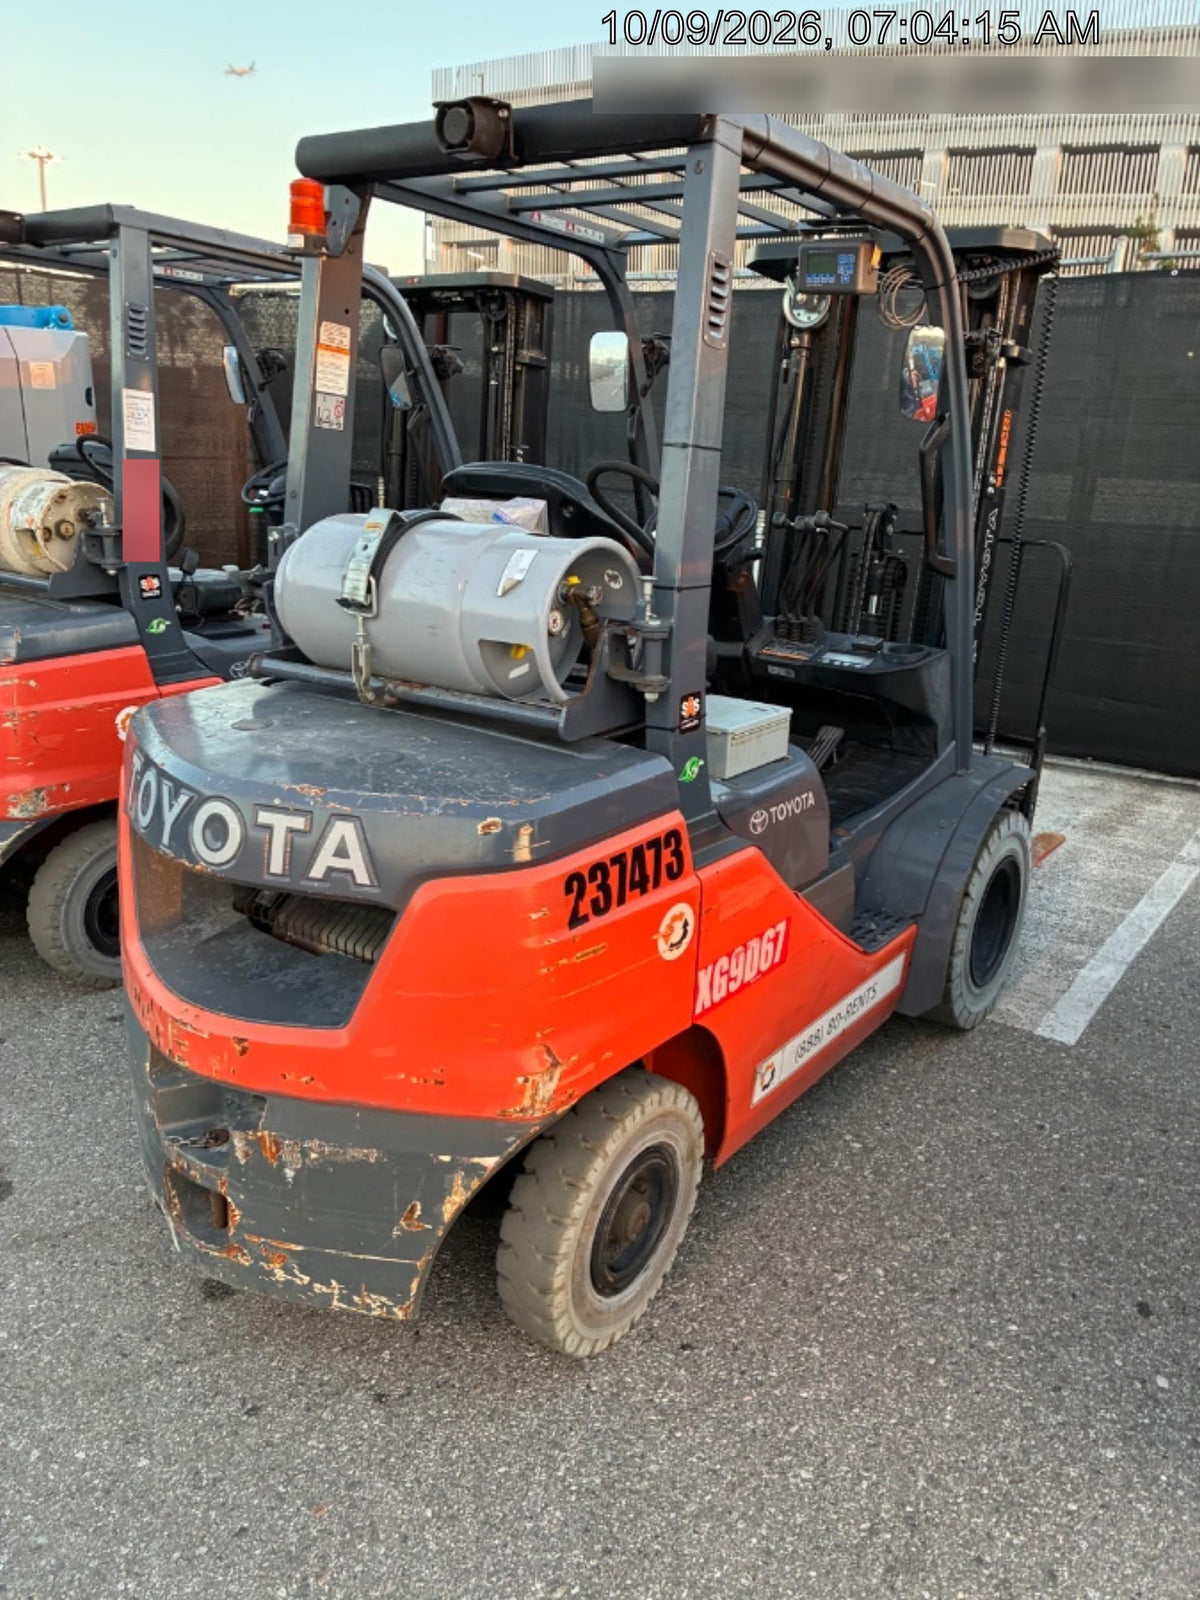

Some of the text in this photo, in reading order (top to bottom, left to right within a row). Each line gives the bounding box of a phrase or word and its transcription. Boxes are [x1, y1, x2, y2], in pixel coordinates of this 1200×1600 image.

[972, 507, 998, 627] TOYOTA
[127, 751, 378, 887] TOYOTA
[769, 791, 815, 825] TOYOTA
[564, 828, 684, 931] 237473
[695, 919, 787, 1016] XG9D67
